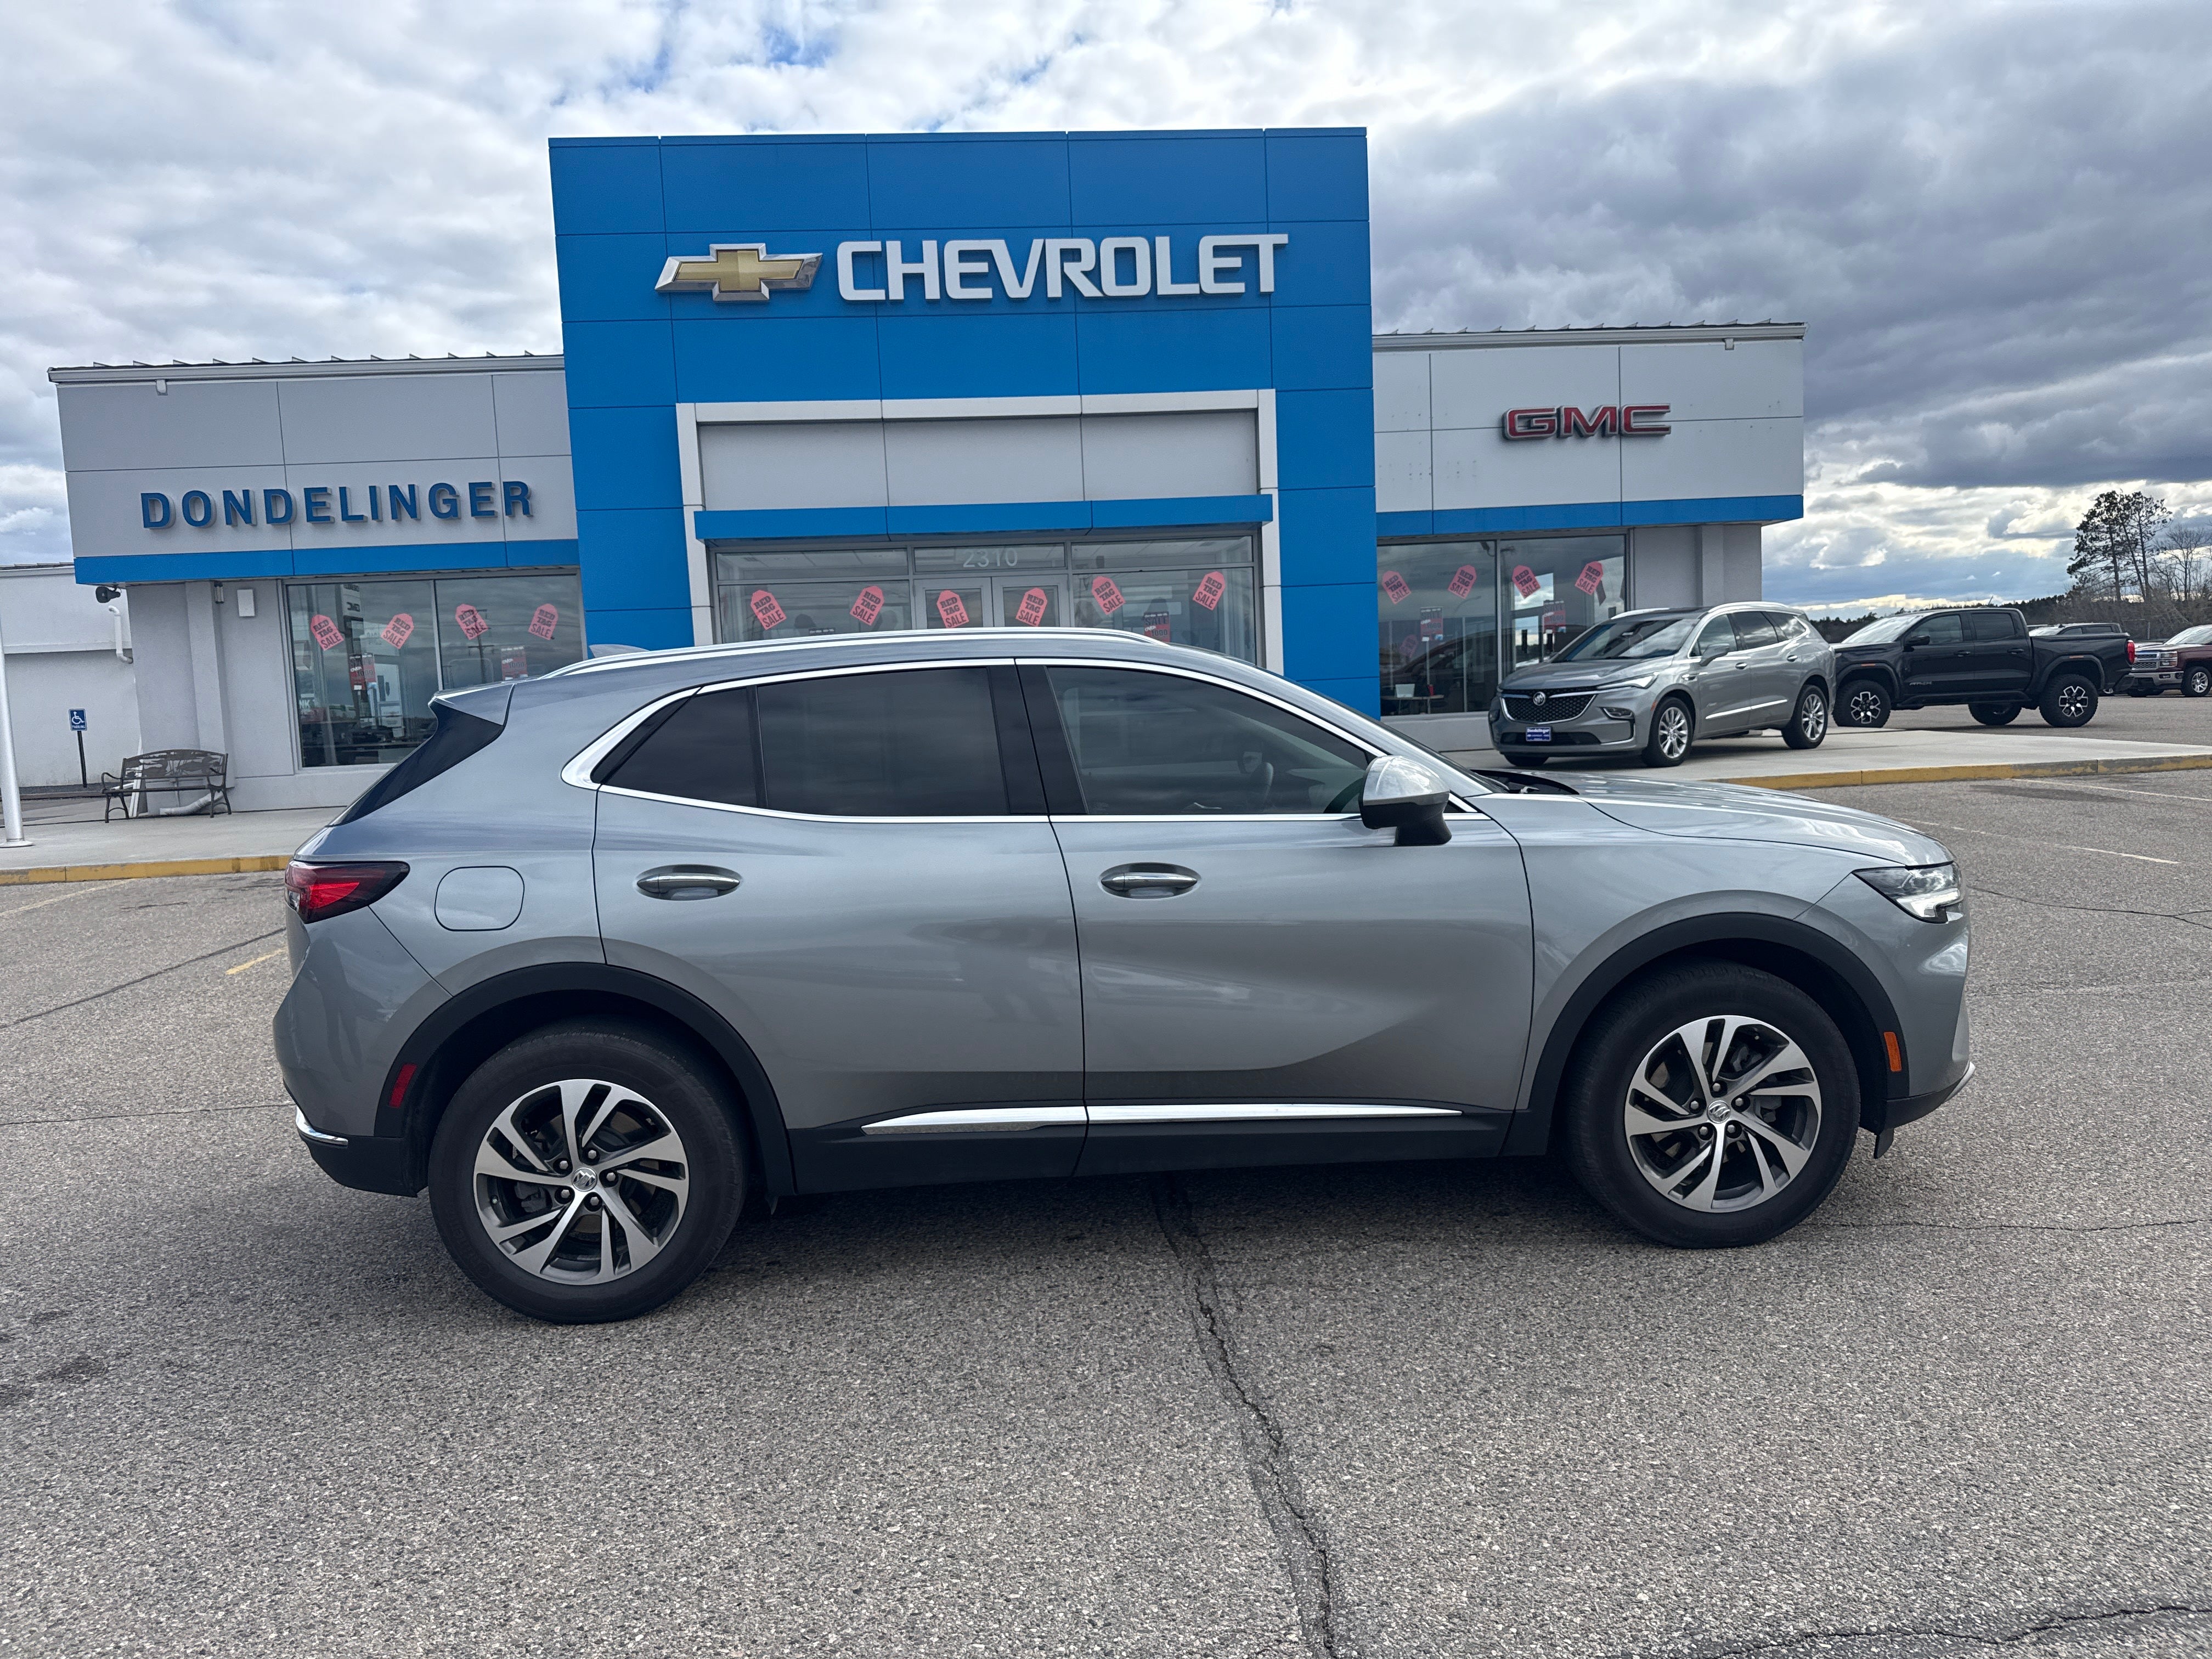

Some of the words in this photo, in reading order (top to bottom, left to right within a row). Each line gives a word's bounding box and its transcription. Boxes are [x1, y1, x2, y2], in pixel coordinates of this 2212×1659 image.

[837, 235, 1289, 301] CHEVROLET
[1503, 403, 1671, 439] GMC
[140, 481, 532, 529] DONDELINGER
[963, 548, 1018, 568] 2310
[1459, 569, 1474, 581] RED
[1515, 569, 1530, 582] RED
[1586, 566, 1601, 577] RED
[1206, 577, 1222, 590] RED
[1384, 575, 1398, 587] RED
[1457, 577, 1470, 587] TAG
[1519, 575, 1533, 587] TAG
[1584, 573, 1597, 584] TAG
[1094, 582, 1111, 595] RED
[1203, 584, 1218, 597] TAG
[1389, 581, 1403, 592] TAG
[1450, 582, 1469, 598] SALE
[1522, 580, 1540, 597] SALE
[1577, 578, 1595, 594] SALE
[864, 591, 881, 604] RED
[1027, 594, 1045, 606] RED
[1099, 588, 1115, 601] TAG
[1195, 591, 1216, 609] SALE
[1392, 586, 1409, 602] SALE
[753, 596, 771, 609] RED
[861, 599, 876, 611] TAG
[940, 597, 957, 608] RED
[1025, 602, 1041, 613] TAG
[1103, 595, 1123, 613] SALE
[538, 609, 555, 620] RED
[758, 603, 775, 616] TAG
[853, 606, 874, 623] SALE
[944, 605, 960, 616] TAG
[537, 617, 552, 627] TAG
[763, 610, 783, 628] SALE
[946, 612, 966, 628] SALE
[1018, 610, 1040, 625] SALE
[1145, 617, 1168, 627] SALE
[313, 620, 329, 631] RED
[392, 624, 406, 636] TAG
[394, 618, 411, 631] RED
[531, 624, 551, 637] SALE
[318, 626, 333, 637] TAG
[321, 632, 341, 648] SALE
[383, 630, 403, 647] SALE
